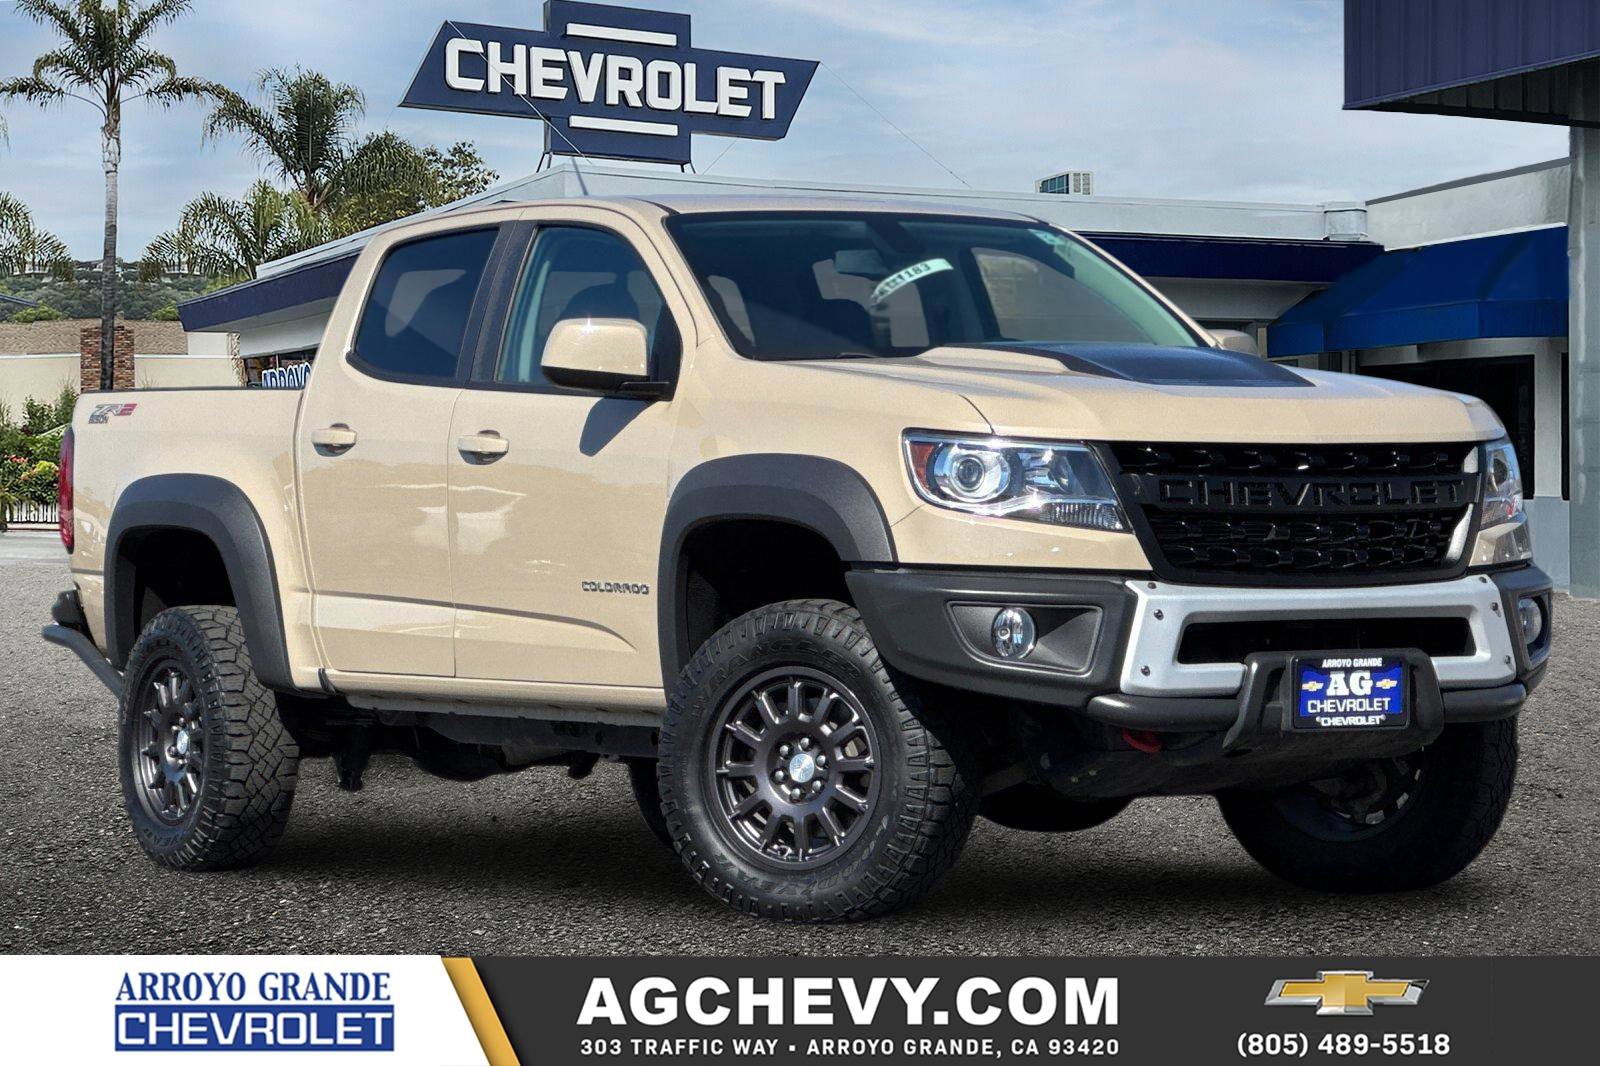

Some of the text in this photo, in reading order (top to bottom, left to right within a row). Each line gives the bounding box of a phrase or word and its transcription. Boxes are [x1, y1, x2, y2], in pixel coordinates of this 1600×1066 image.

[445, 37, 786, 120] CHEVROLET
[1158, 478, 1465, 507] CHEVROLET
[581, 581, 650, 595] COLORADO
[1322, 657, 1383, 669] ARROYO GRANDE
[1326, 669, 1374, 696] AG
[1307, 697, 1391, 714] CHEVROLET
[1321, 715, 1383, 727] CHEVROLET
